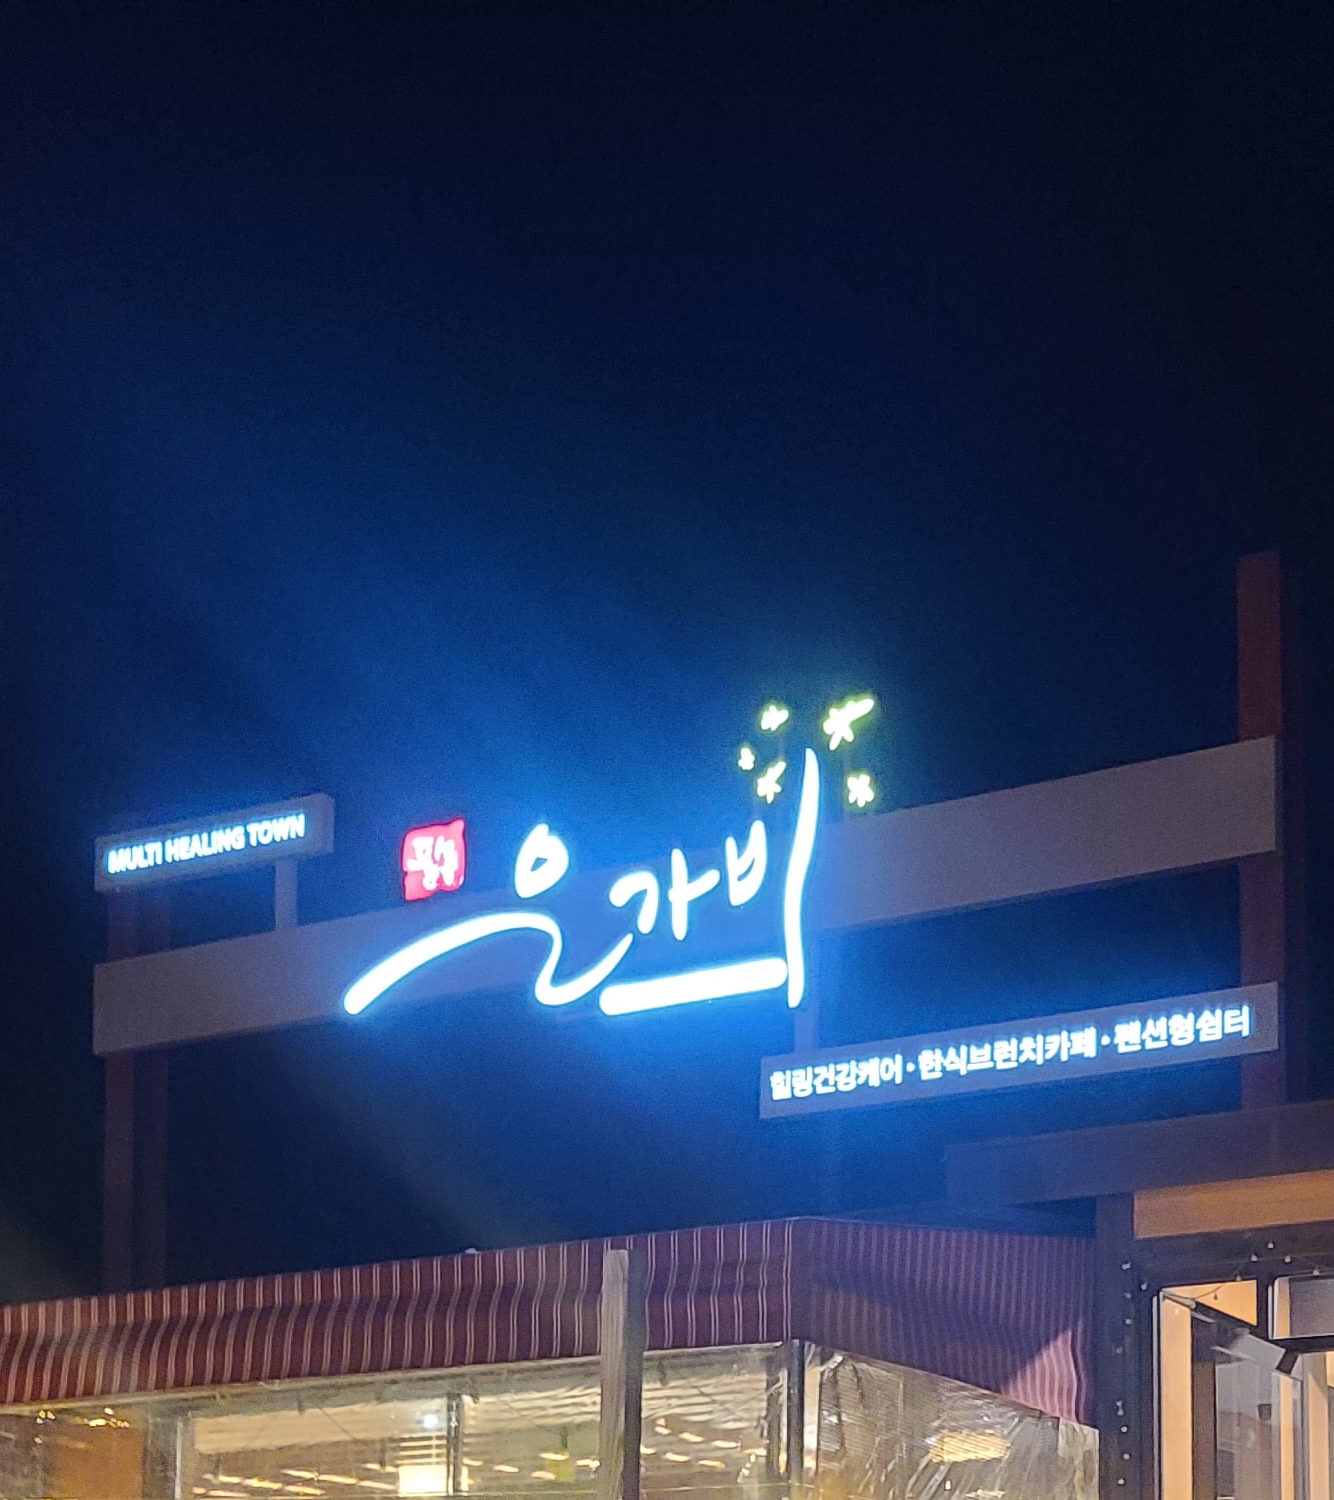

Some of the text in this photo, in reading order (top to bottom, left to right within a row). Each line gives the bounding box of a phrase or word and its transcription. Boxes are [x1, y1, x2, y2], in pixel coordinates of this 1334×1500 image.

[107, 813, 306, 874] MULTI HEALING TOWN
[344, 747, 820, 1015] 은가비
